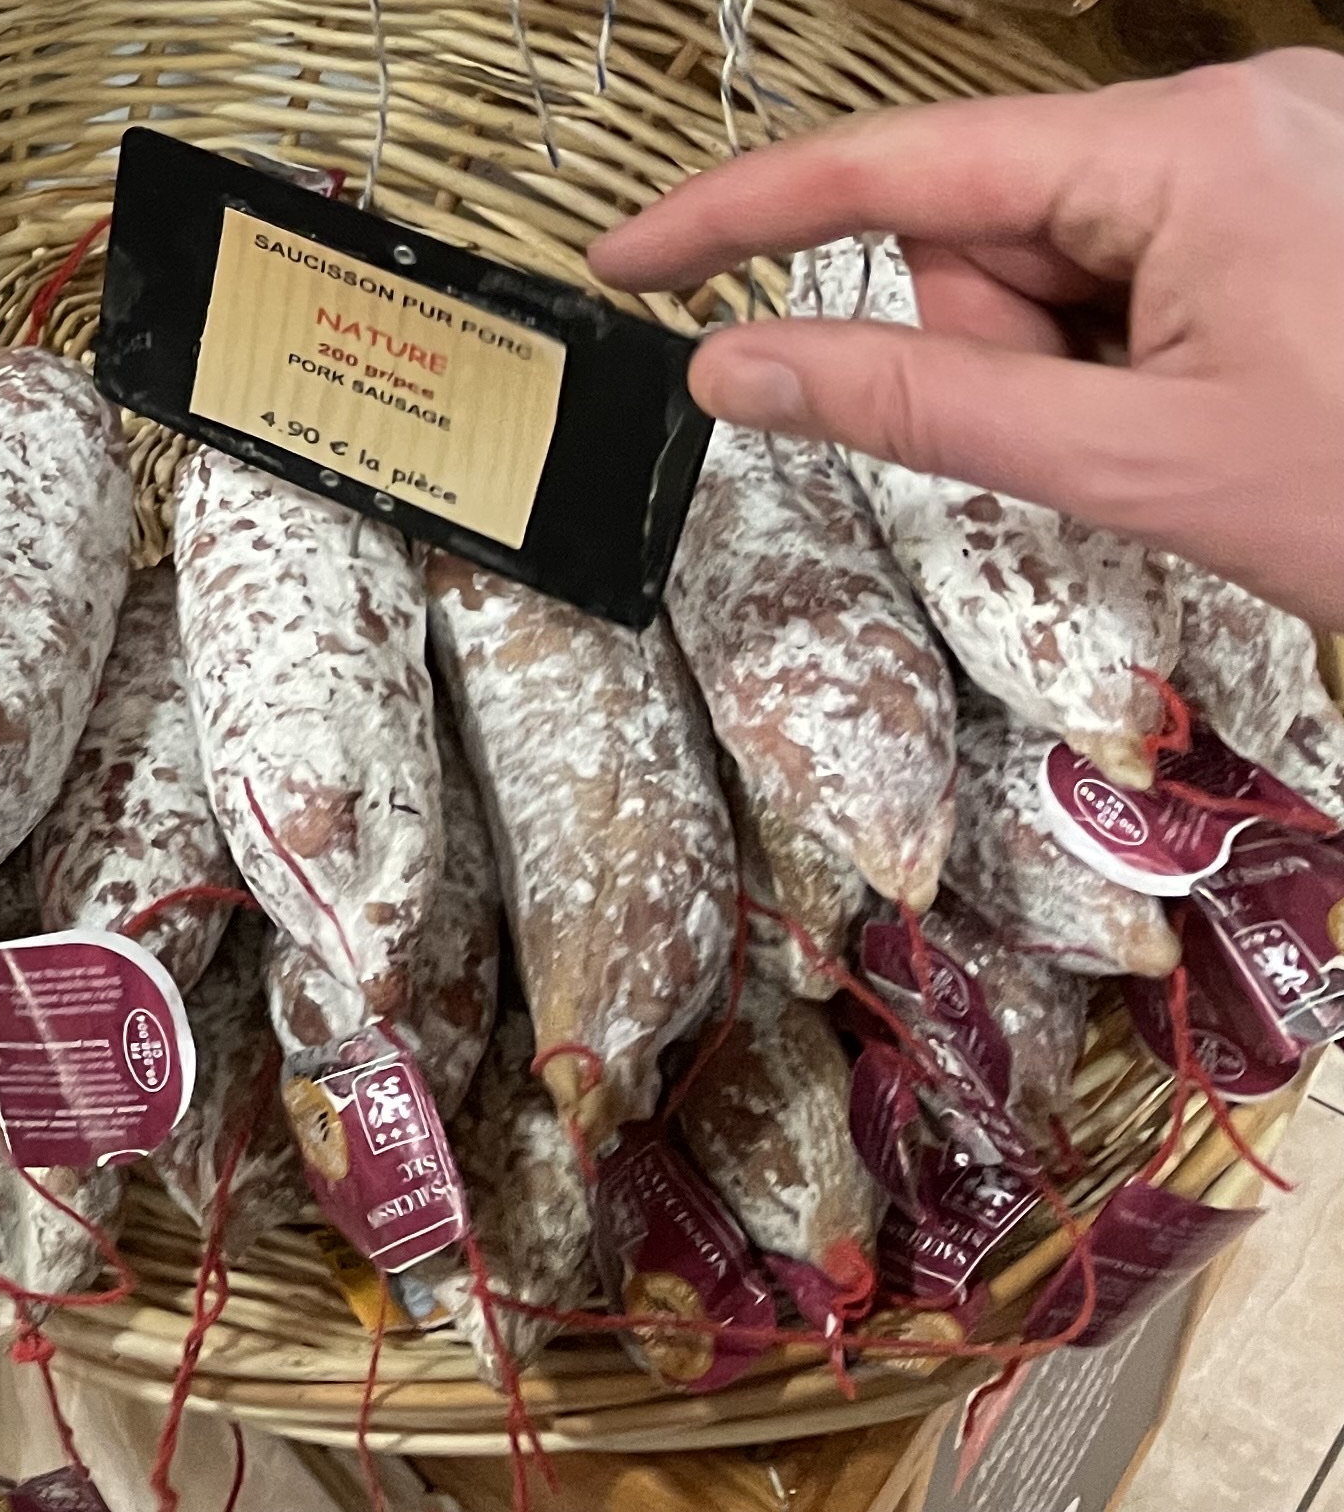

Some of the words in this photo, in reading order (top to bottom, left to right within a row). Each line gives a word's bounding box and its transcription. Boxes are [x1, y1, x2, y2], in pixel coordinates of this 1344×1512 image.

[253, 234, 395, 302] SAUCISSON
[402, 294, 453, 329] PUR
[461, 319, 533, 361] PORC
[315, 305, 449, 377] NATURE
[316, 342, 359, 368] 200
[287, 352, 345, 387] PORK
[351, 379, 452, 432] SAUSAGE
[259, 410, 321, 445] 4.90
[329, 440, 349, 457] €
[358, 448, 381, 473] la
[391, 467, 458, 506] pièce
